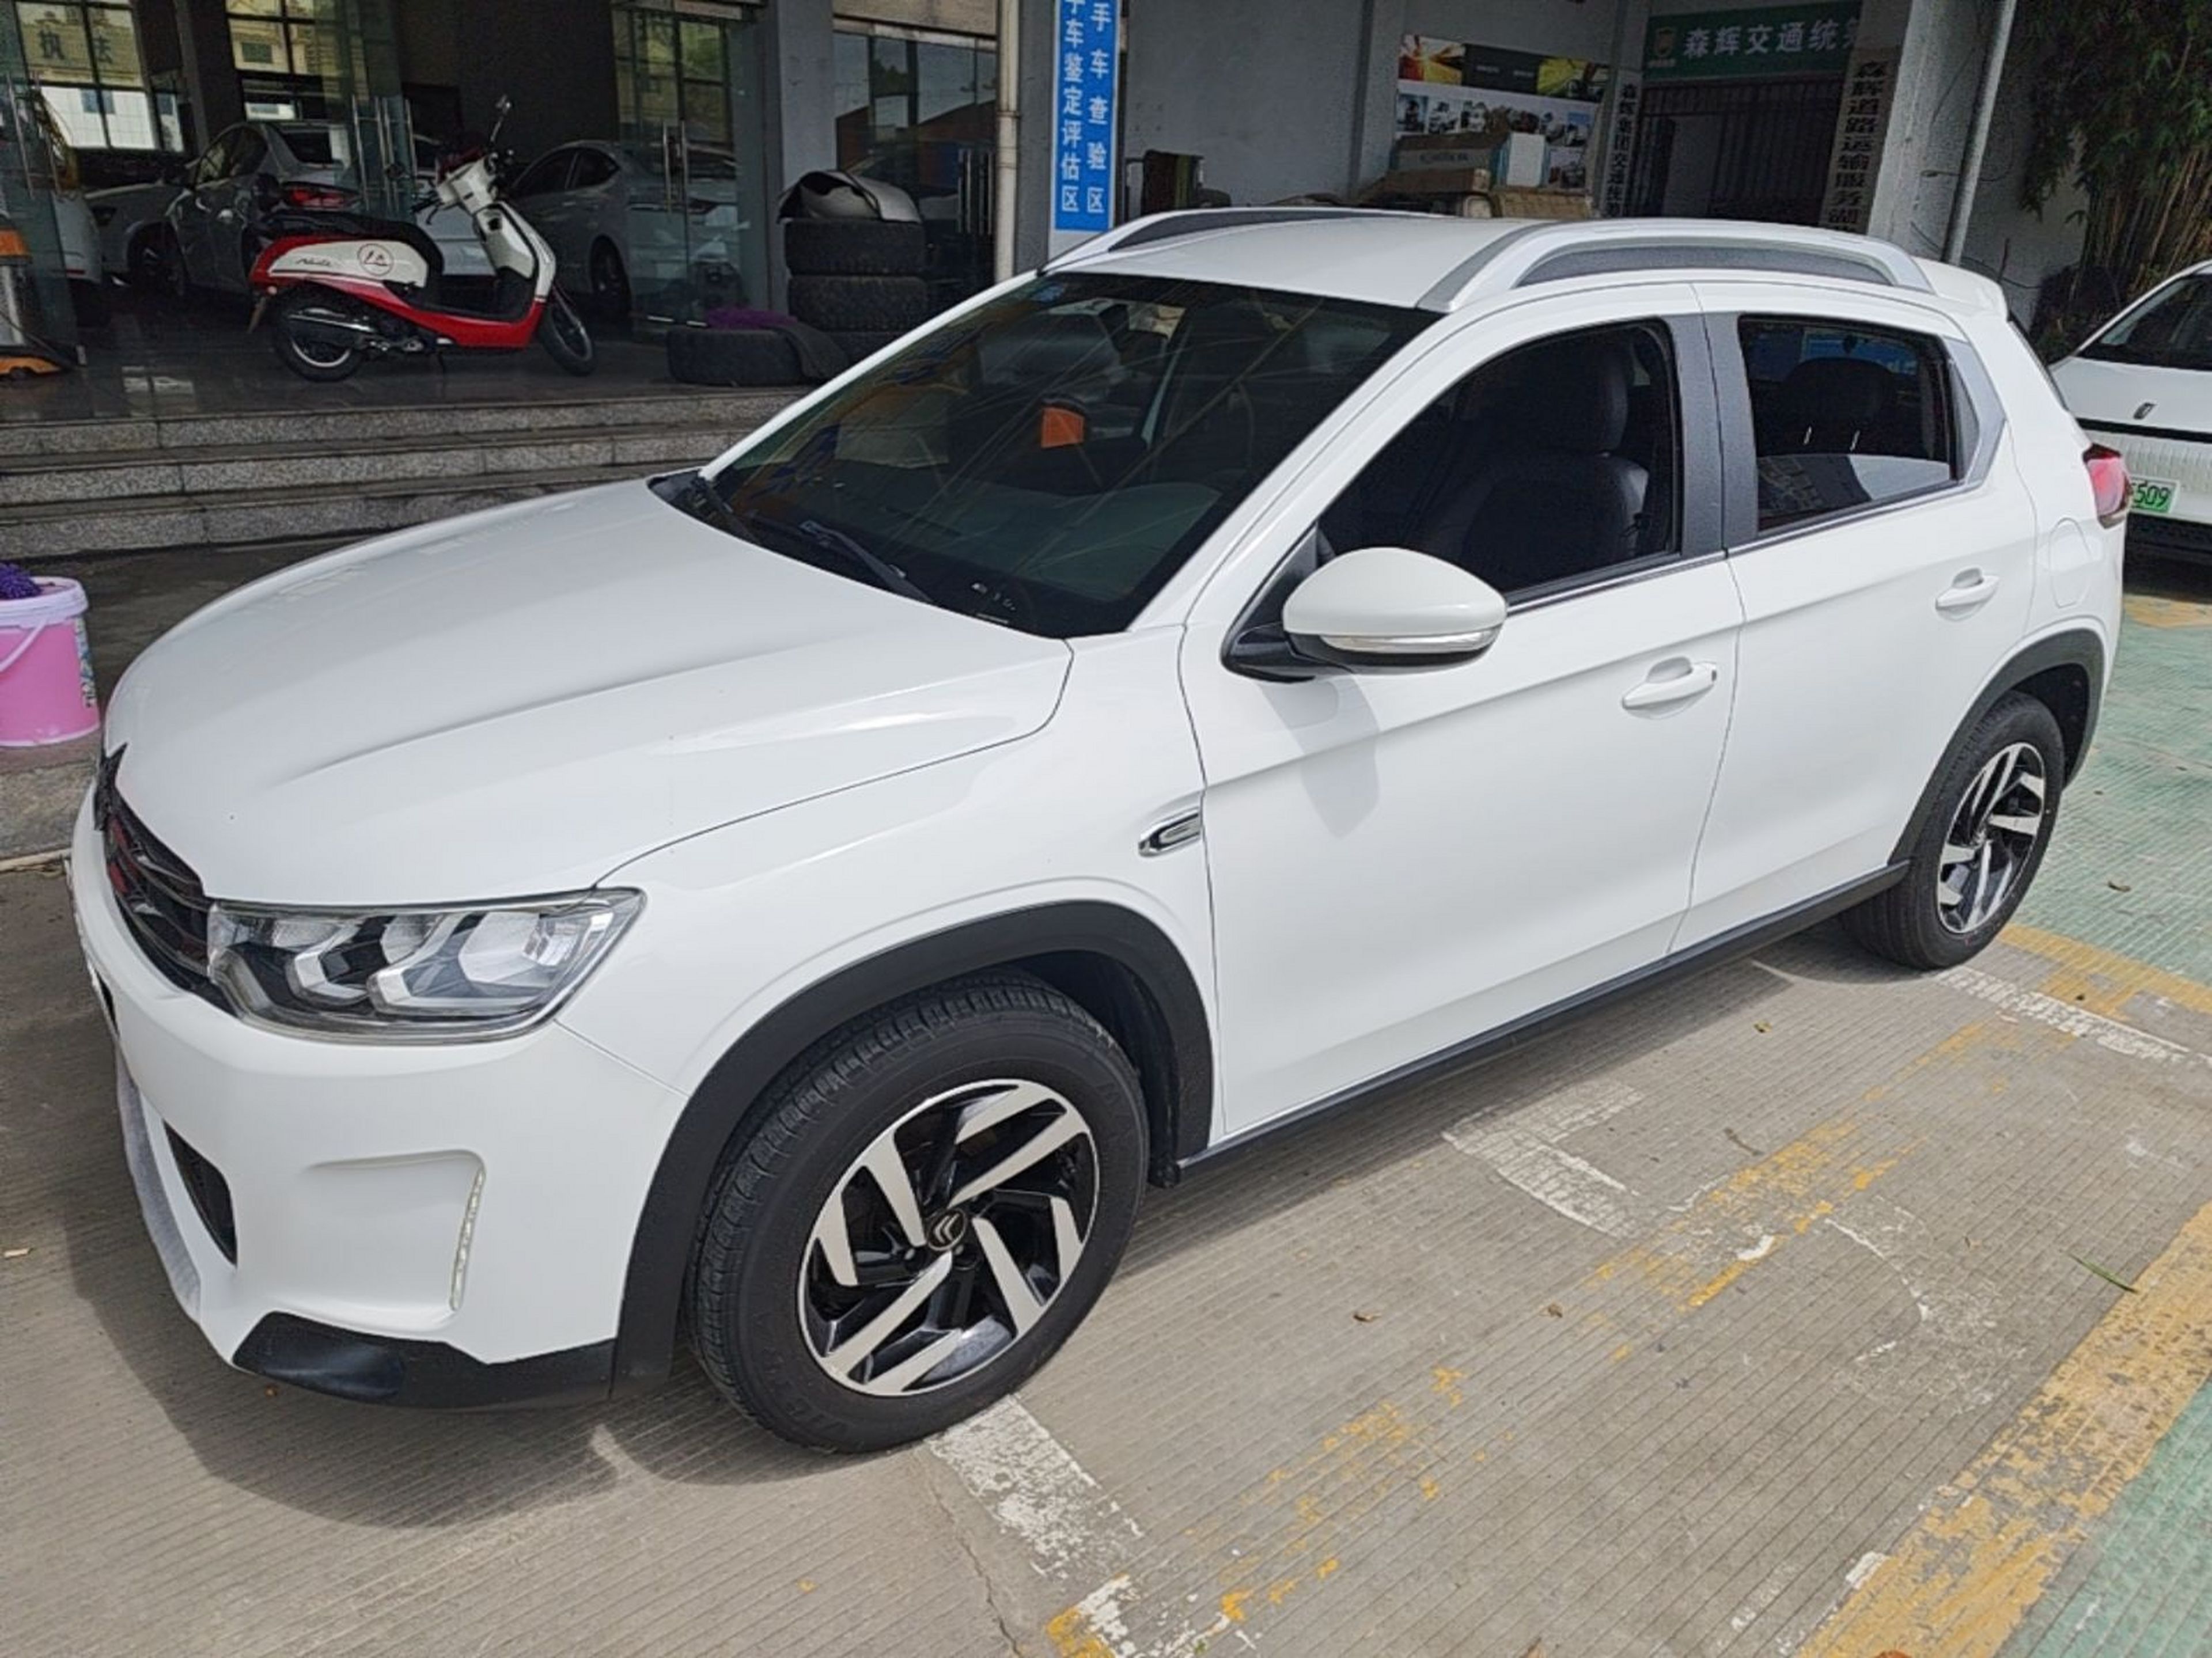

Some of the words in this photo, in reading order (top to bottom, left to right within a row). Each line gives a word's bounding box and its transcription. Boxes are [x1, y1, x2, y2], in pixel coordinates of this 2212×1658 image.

[1087, 3, 1111, 213] 手车查验区
[1827, 60, 1887, 232] 森辉道路运输服务湖
[2132, 480, 2171, 508] 509
